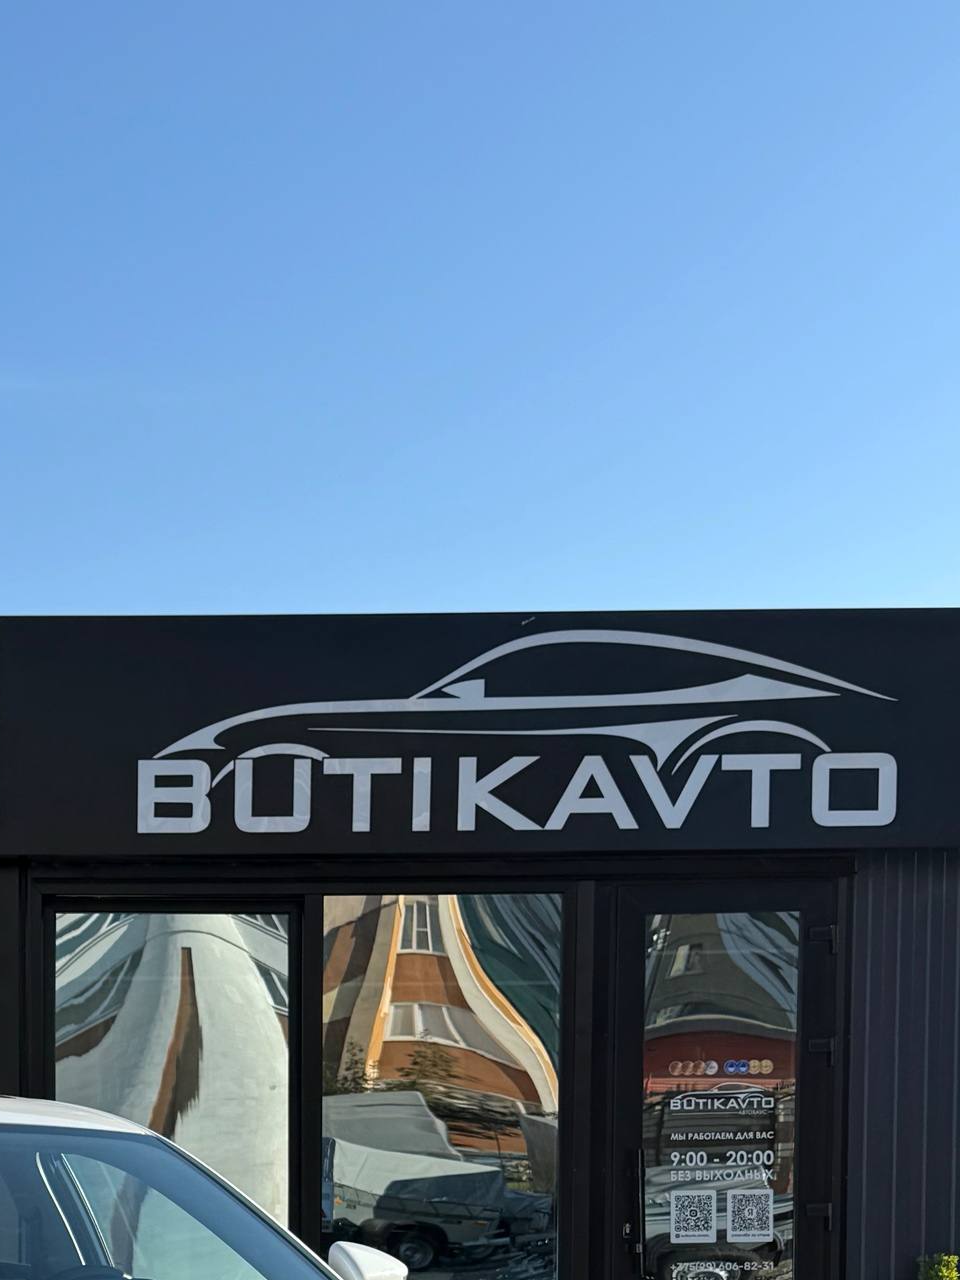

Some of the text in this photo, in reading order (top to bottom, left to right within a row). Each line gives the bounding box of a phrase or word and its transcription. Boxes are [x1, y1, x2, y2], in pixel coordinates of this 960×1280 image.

[136, 751, 897, 834] BUTIKAVTO
[670, 1097, 775, 1110] BUTIKAVTO
[670, 1131, 775, 1141] МЫ РАБОТАЕМ ДЛЯ ВАС
[670, 1151, 708, 1166] 9:00
[726, 1150, 775, 1166] 20:00
[670, 1169, 773, 1182] БЕЗ ВЫХОДНЫХ
[719, 1261, 775, 1271] 606-82-31
